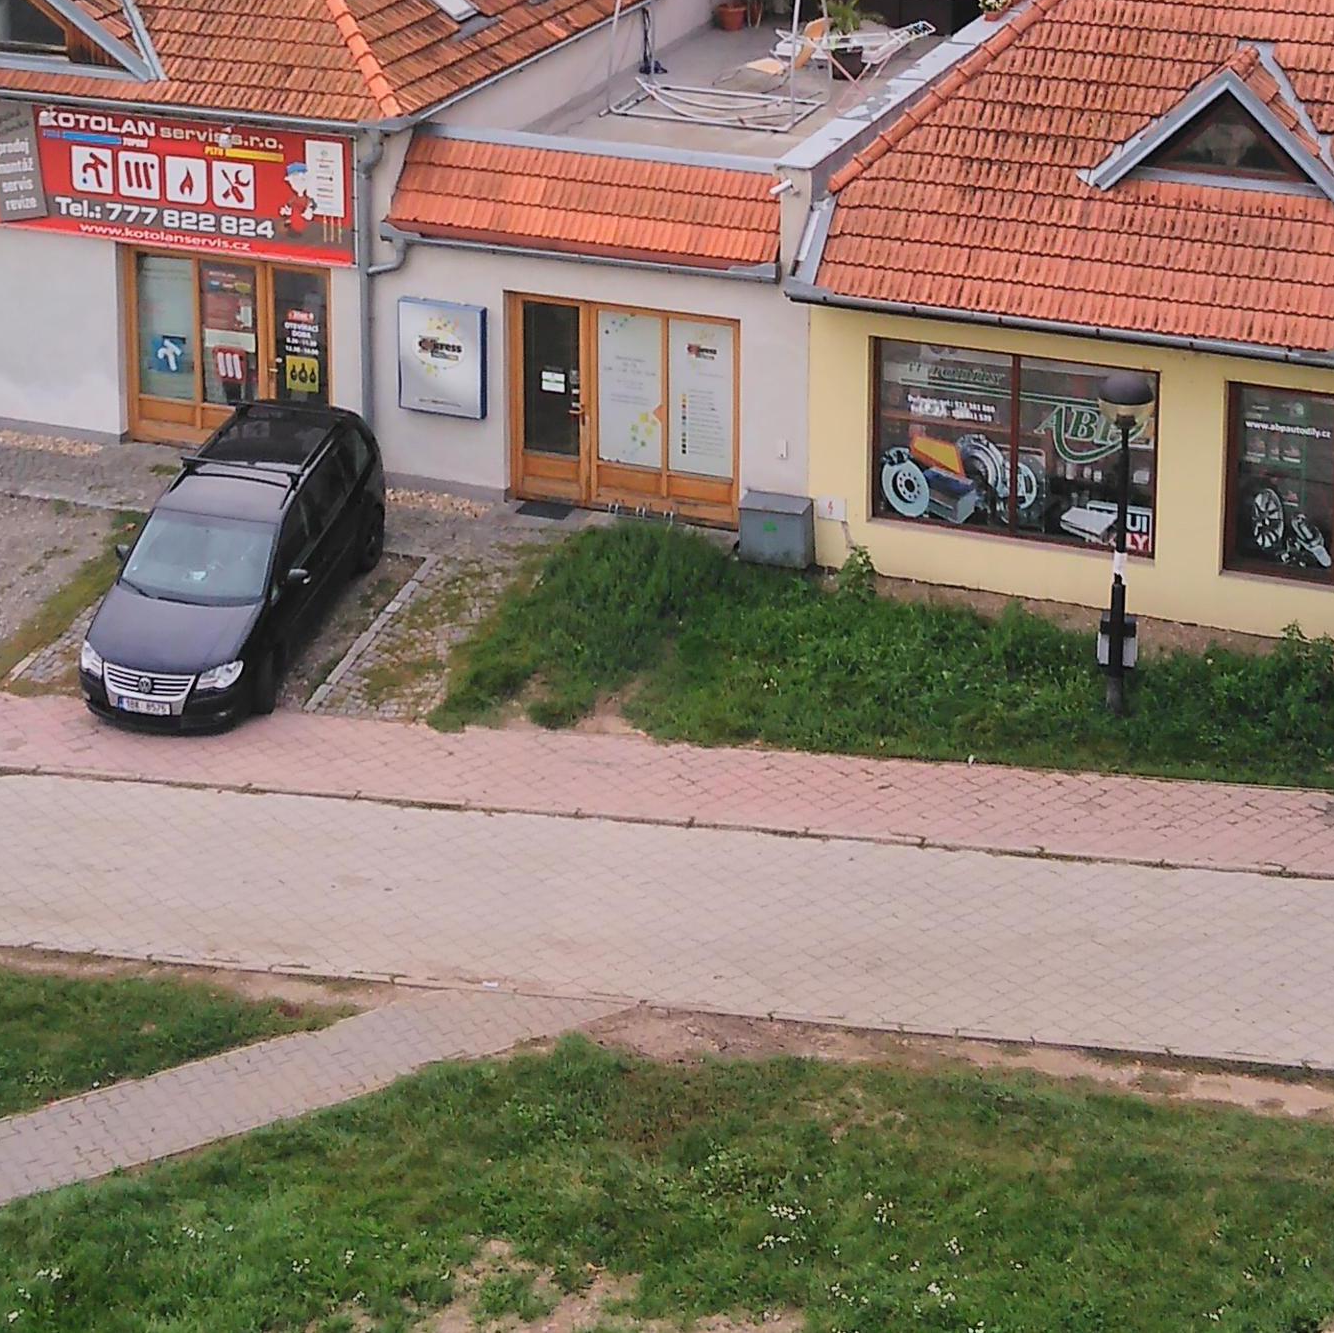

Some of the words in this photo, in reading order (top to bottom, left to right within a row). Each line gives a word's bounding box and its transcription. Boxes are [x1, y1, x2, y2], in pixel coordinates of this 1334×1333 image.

[38, 111, 156, 136] KOTOLAN
[2, 176, 33, 193] servis
[6, 195, 37, 211] revize
[55, 197, 102, 218] Tel.:
[106, 203, 158, 225] 777
[163, 210, 216, 233] 822
[220, 216, 276, 239] 824
[79, 223, 251, 250] www.kotolanservis.cz
